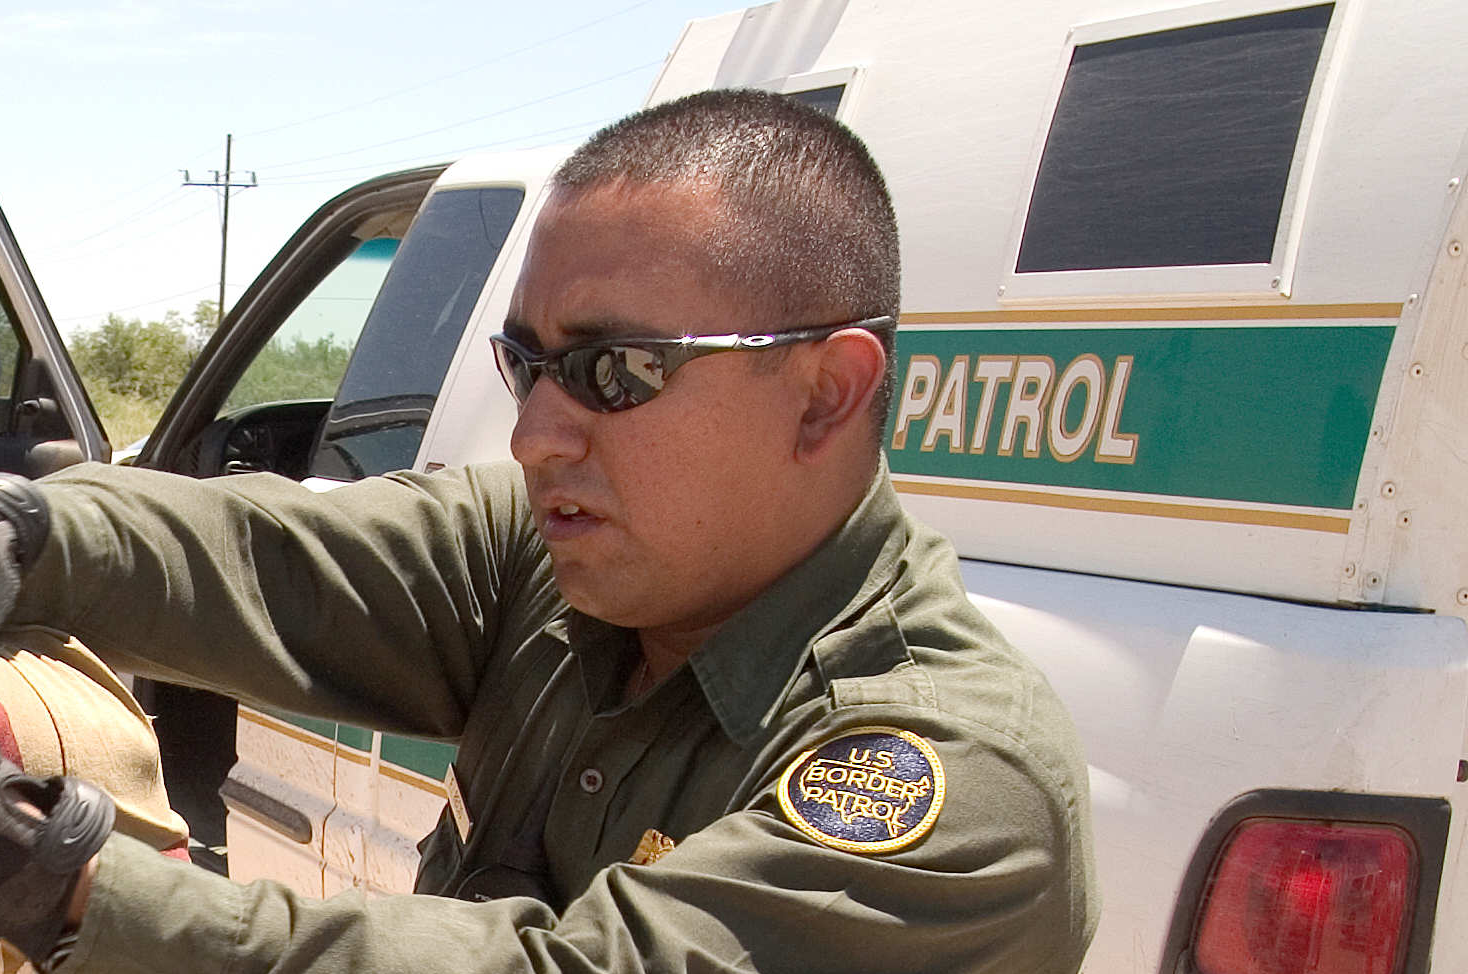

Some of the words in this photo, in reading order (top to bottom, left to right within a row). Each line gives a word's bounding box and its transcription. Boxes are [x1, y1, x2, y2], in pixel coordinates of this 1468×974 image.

[892, 353, 1139, 464] PATROL
[807, 766, 918, 806] BORDER
[803, 787, 908, 829] PATROL
